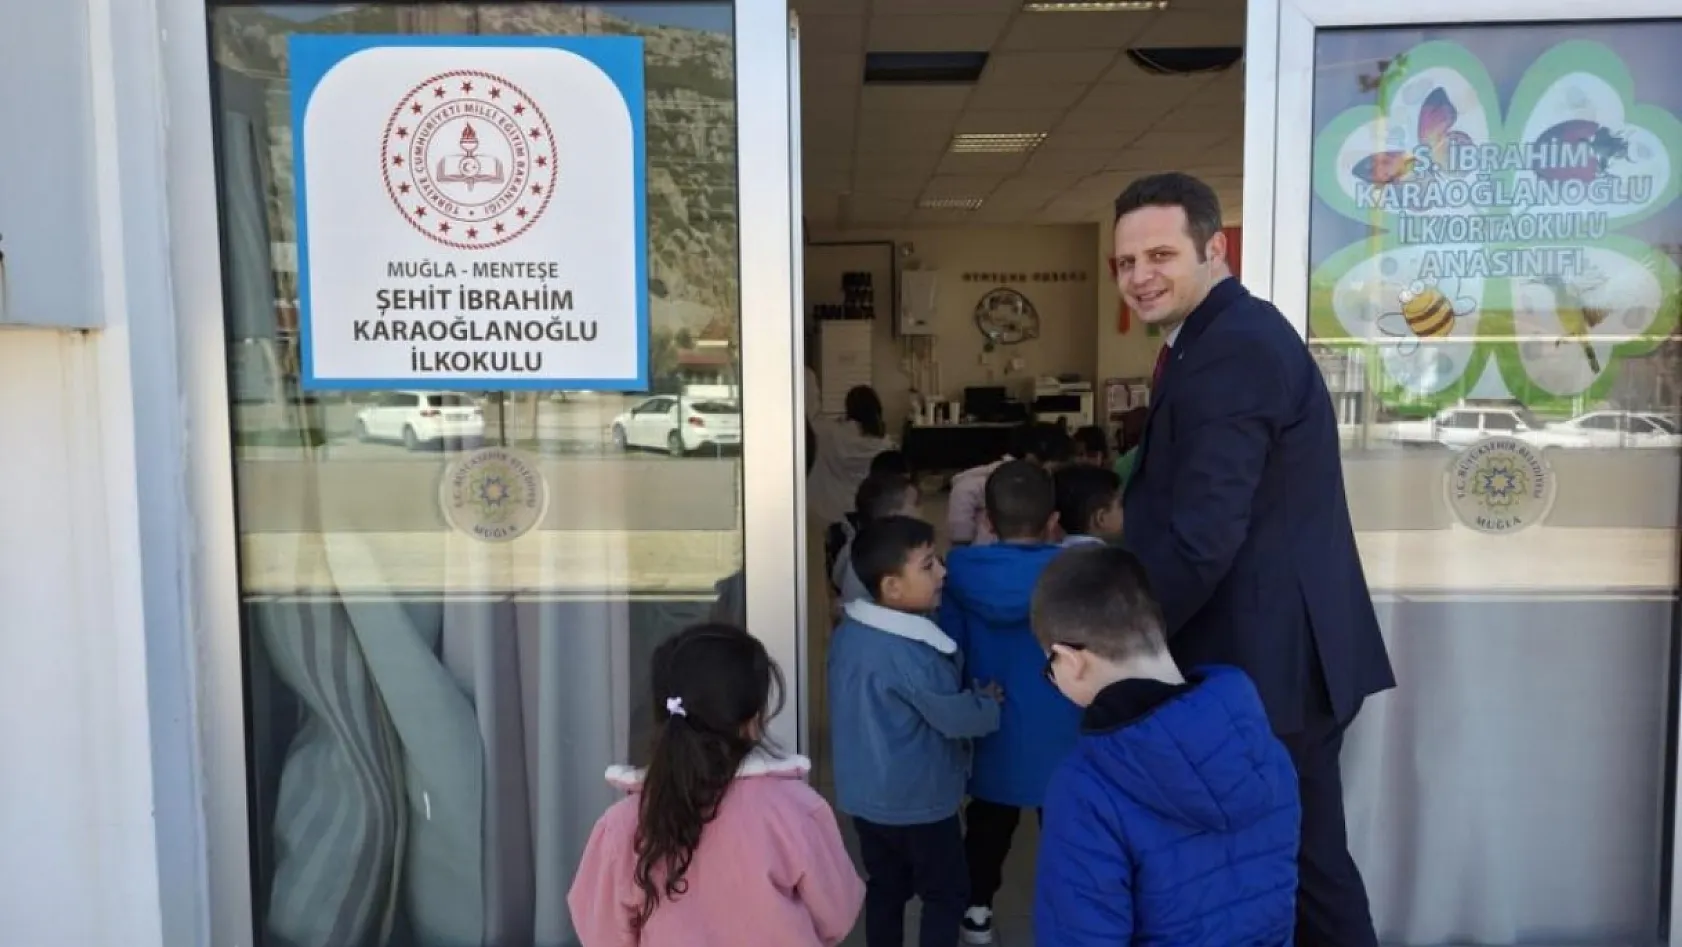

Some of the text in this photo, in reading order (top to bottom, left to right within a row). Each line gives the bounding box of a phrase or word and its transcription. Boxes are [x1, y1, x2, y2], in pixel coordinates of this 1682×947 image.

[1450, 138, 1590, 171] İBRAHİM
[1355, 173, 1653, 209] KARAOĞLANOĞLU
[1399, 211, 1607, 244] İLK/ORTAOKULU
[387, 258, 457, 278] MUĞLA
[473, 261, 559, 282] MENTEŞE
[1419, 248, 1584, 278] ANASINIFI
[376, 284, 574, 315] ŞEHİT İBRAHİM
[353, 316, 598, 341] KARAOĞLANOĞLU
[411, 346, 543, 371] İLKOKULU
